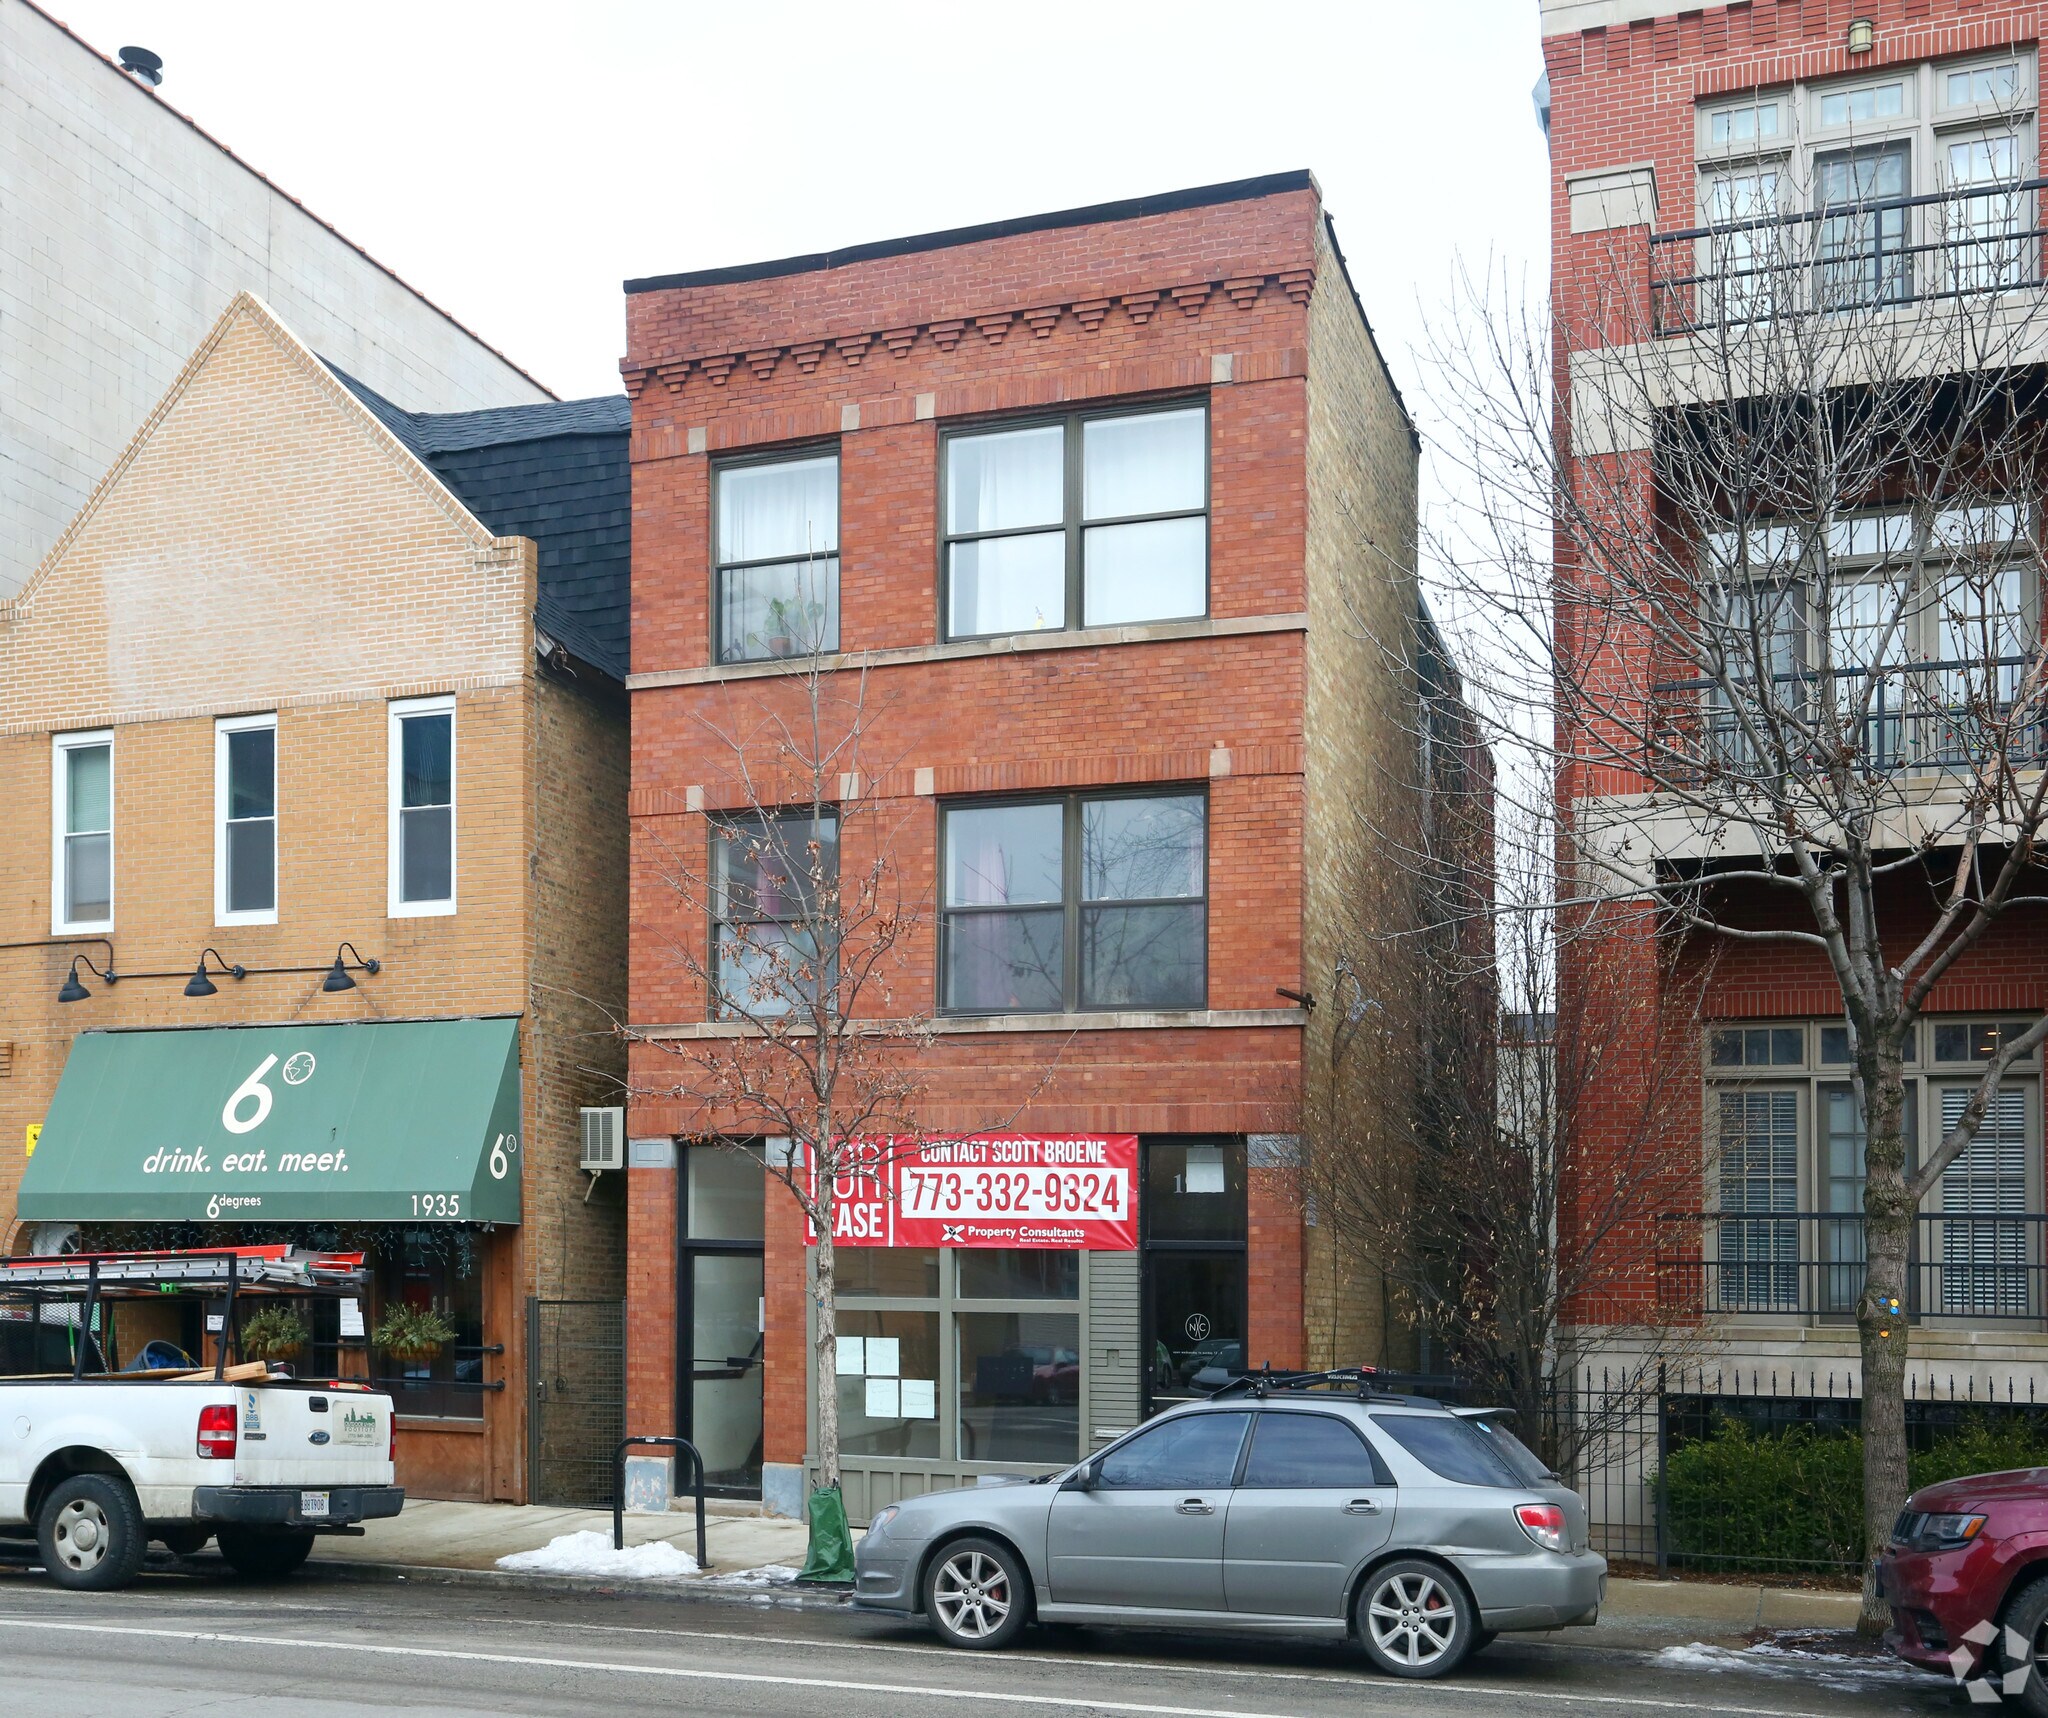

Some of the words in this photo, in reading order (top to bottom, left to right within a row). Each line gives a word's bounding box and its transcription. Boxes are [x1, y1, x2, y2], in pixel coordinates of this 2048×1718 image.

[143, 1146, 211, 1173] drink.
[222, 1149, 268, 1172] eat.
[278, 1149, 349, 1172] meet.
[921, 1141, 989, 1163] CONTACT
[992, 1140, 1039, 1163] SCOTT
[1044, 1141, 1107, 1163] BROENE
[219, 1193, 262, 1210] degrees
[910, 1173, 1119, 1212] 773-332-9324
[411, 1194, 459, 1217] 1935
[809, 1203, 884, 1237] LASE
[968, 1226, 1016, 1239] Property
[1019, 1226, 1085, 1238] Consultants
